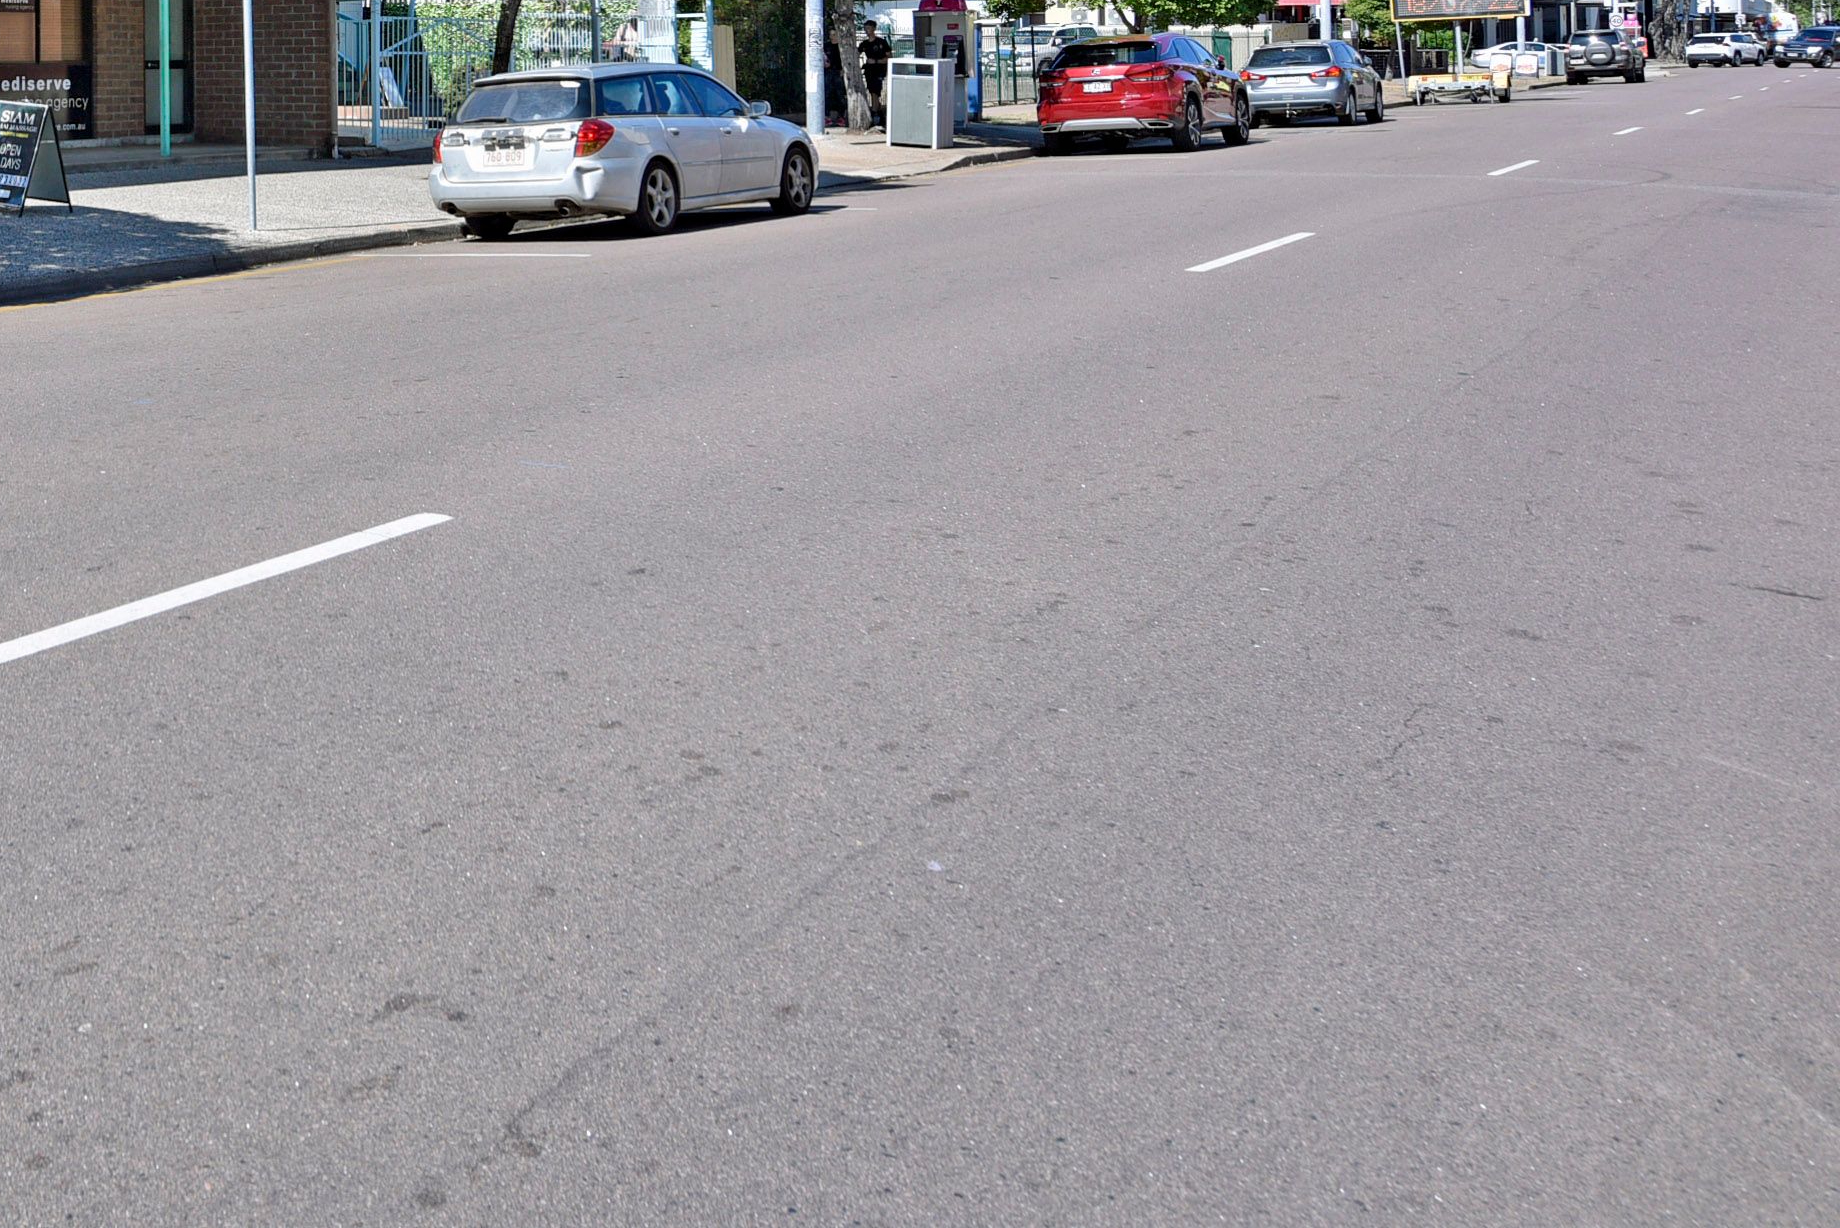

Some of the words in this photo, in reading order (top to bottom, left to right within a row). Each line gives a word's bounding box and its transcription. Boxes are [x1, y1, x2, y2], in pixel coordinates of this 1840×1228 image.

[46, 96, 89, 111] agency
[0, 110, 36, 125] SIAM
[9, 123, 38, 133] MASSAGE
[0, 143, 22, 157] OPEN
[0, 158, 22, 171] DAYS
